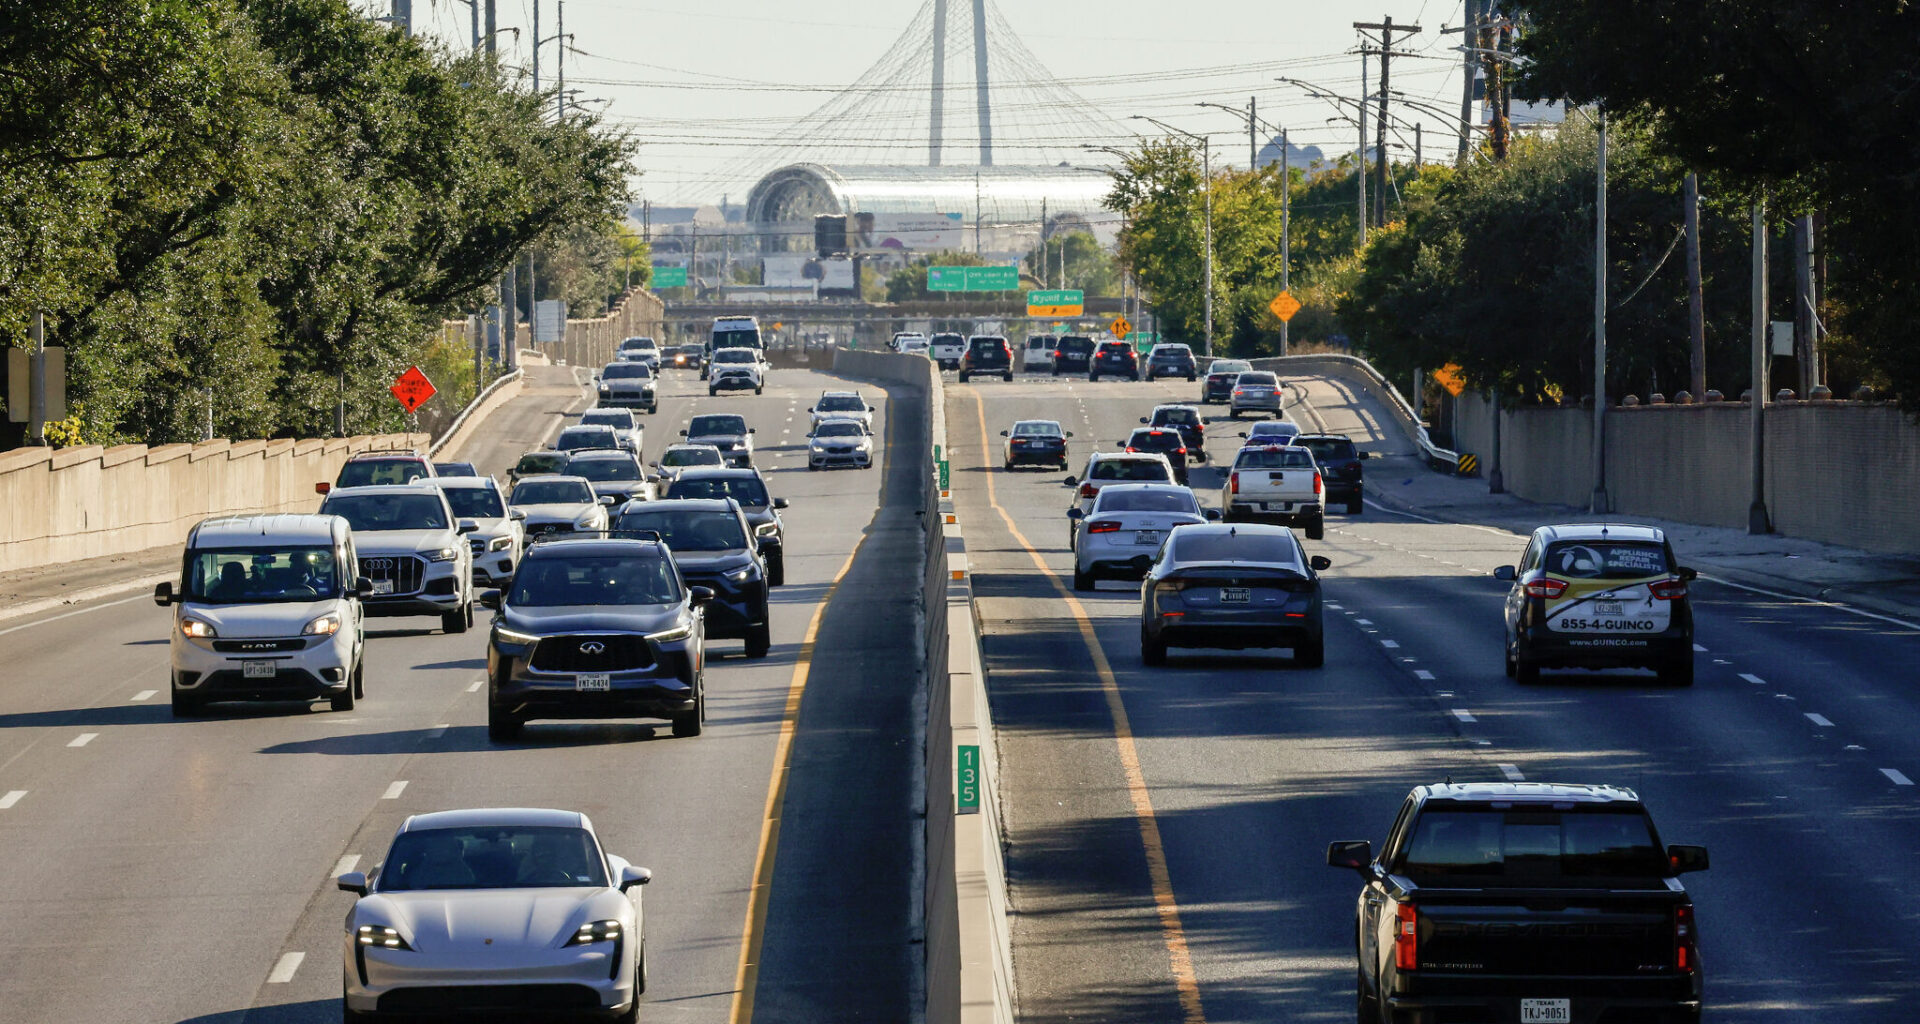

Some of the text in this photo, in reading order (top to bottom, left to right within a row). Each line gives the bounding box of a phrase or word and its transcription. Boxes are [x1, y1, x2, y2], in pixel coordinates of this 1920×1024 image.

[1610, 549, 1659, 560] APPLIANCE
[1620, 555, 1650, 563] REPAIR
[1608, 560, 1662, 571] SPECIALISTS
[1561, 618, 1654, 630] 855-4-GUINCO
[963, 750, 976, 802] 135
[1523, 1007, 1567, 1020] TKJ-9051
